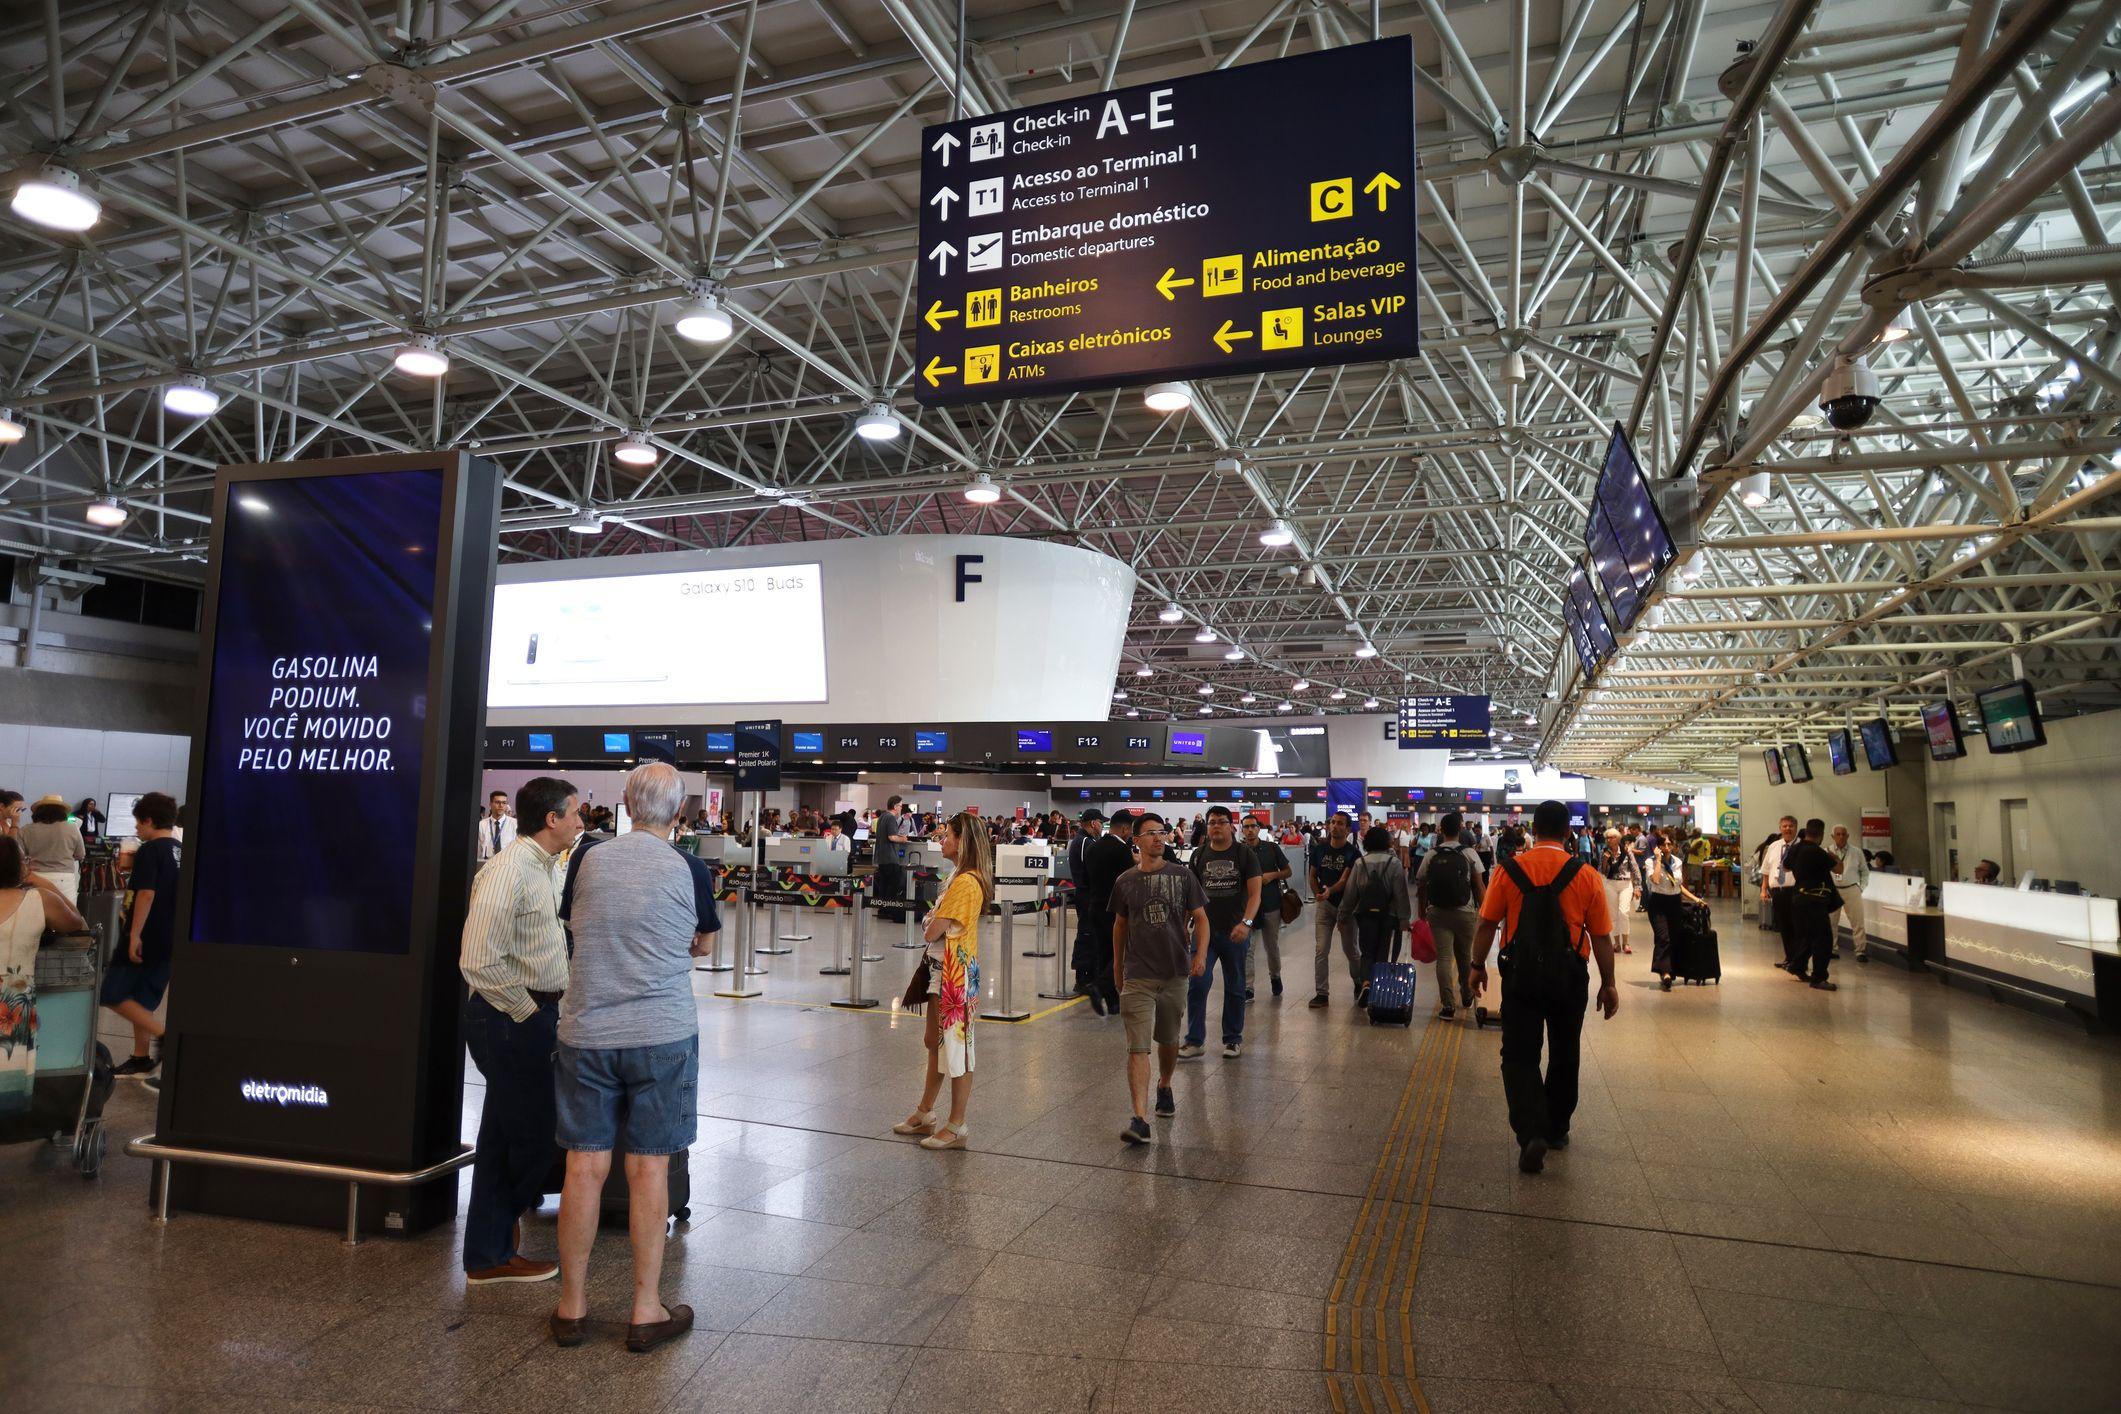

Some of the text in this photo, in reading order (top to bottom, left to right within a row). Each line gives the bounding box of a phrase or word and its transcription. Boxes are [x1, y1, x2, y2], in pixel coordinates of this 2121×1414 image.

[1013, 88, 1174, 139] Check-in A-E
[1013, 134, 1070, 154] Check-in
[1012, 144, 1196, 189] Acesso ao Terminal 1
[976, 188, 998, 206] T1
[1012, 177, 1148, 210] Access to Terminal 1
[1320, 185, 1345, 214] C
[1012, 203, 1209, 245] Embarque doméstico
[1012, 236, 1154, 266] Domestic departures
[1253, 238, 1380, 268] Alimentação
[1254, 262, 1405, 291] Food and beverage
[1011, 278, 1098, 301] Banheiros
[1010, 304, 1081, 322] Restrooms
[1314, 296, 1405, 322] Salas VIP
[1009, 327, 1171, 358] Caixas eletrônicos
[1315, 328, 1382, 345] Lounges
[1008, 364, 1045, 380] ATMs
[681, 577, 804, 595] Galaxy S10 Buds
[956, 555, 983, 602] F
[272, 656, 378, 678] GASOLINA
[269, 687, 360, 708] PODIUM.
[1435, 698, 1452, 706] A-E
[243, 712, 391, 739] VOCÊ MOVIDO
[1384, 722, 1396, 740] E
[676, 740, 690, 748] F15
[841, 739, 858, 747] F14
[880, 738, 897, 746] F13
[1078, 738, 1098, 746] F12
[1129, 738, 1147, 747] F11
[238, 749, 394, 771] PELO MELHOR.
[758, 759, 777, 767] Polaris
[1028, 858, 1043, 868] F12
[242, 1081, 328, 1104] eletromidia
